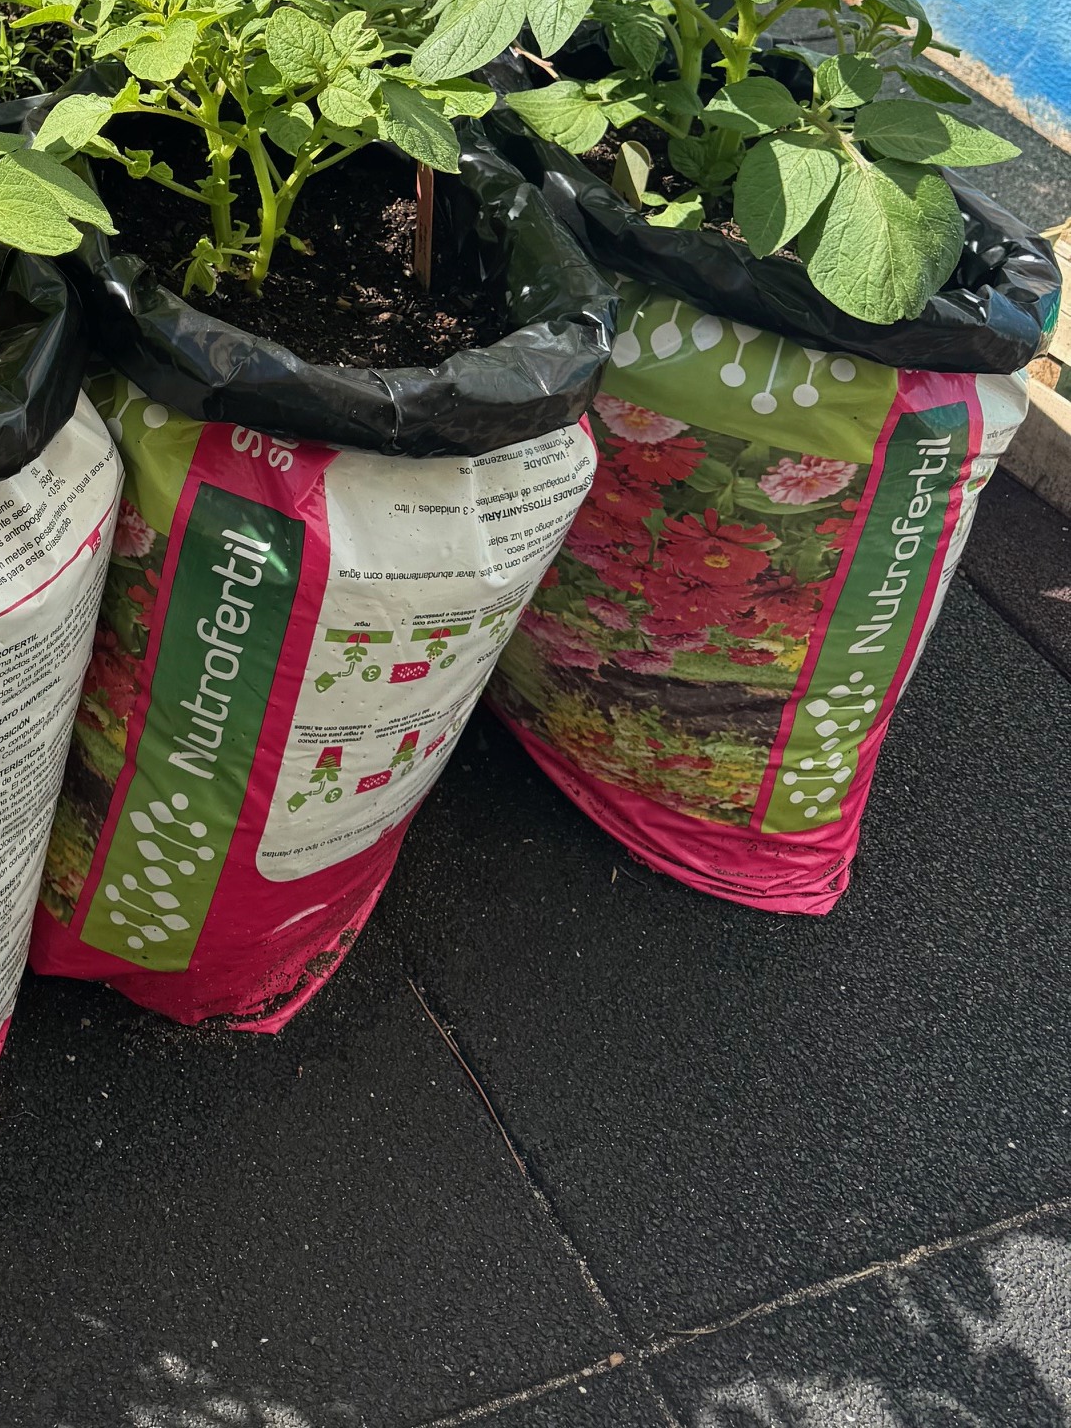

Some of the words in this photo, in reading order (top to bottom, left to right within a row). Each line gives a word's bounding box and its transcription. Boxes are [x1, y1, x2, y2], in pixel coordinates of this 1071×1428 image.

[4, 541, 34, 565] metais
[67, 492, 76, 503] ou
[73, 474, 91, 494] igual
[90, 461, 104, 476] aos
[12, 502, 32, 520] seca
[394, 503, 410, 514] litro
[419, 504, 461, 515] unidades
[510, 533, 523, 541] luz
[524, 528, 533, 537] da
[848, 433, 952, 653] Nutrofertil
[505, 544, 525, 554] seco.
[6, 563, 25, 581] para
[25, 549, 45, 566] esta
[505, 559, 521, 568] com
[338, 569, 361, 579] água.
[364, 570, 383, 579] com
[168, 529, 271, 780] Nutrofertil
